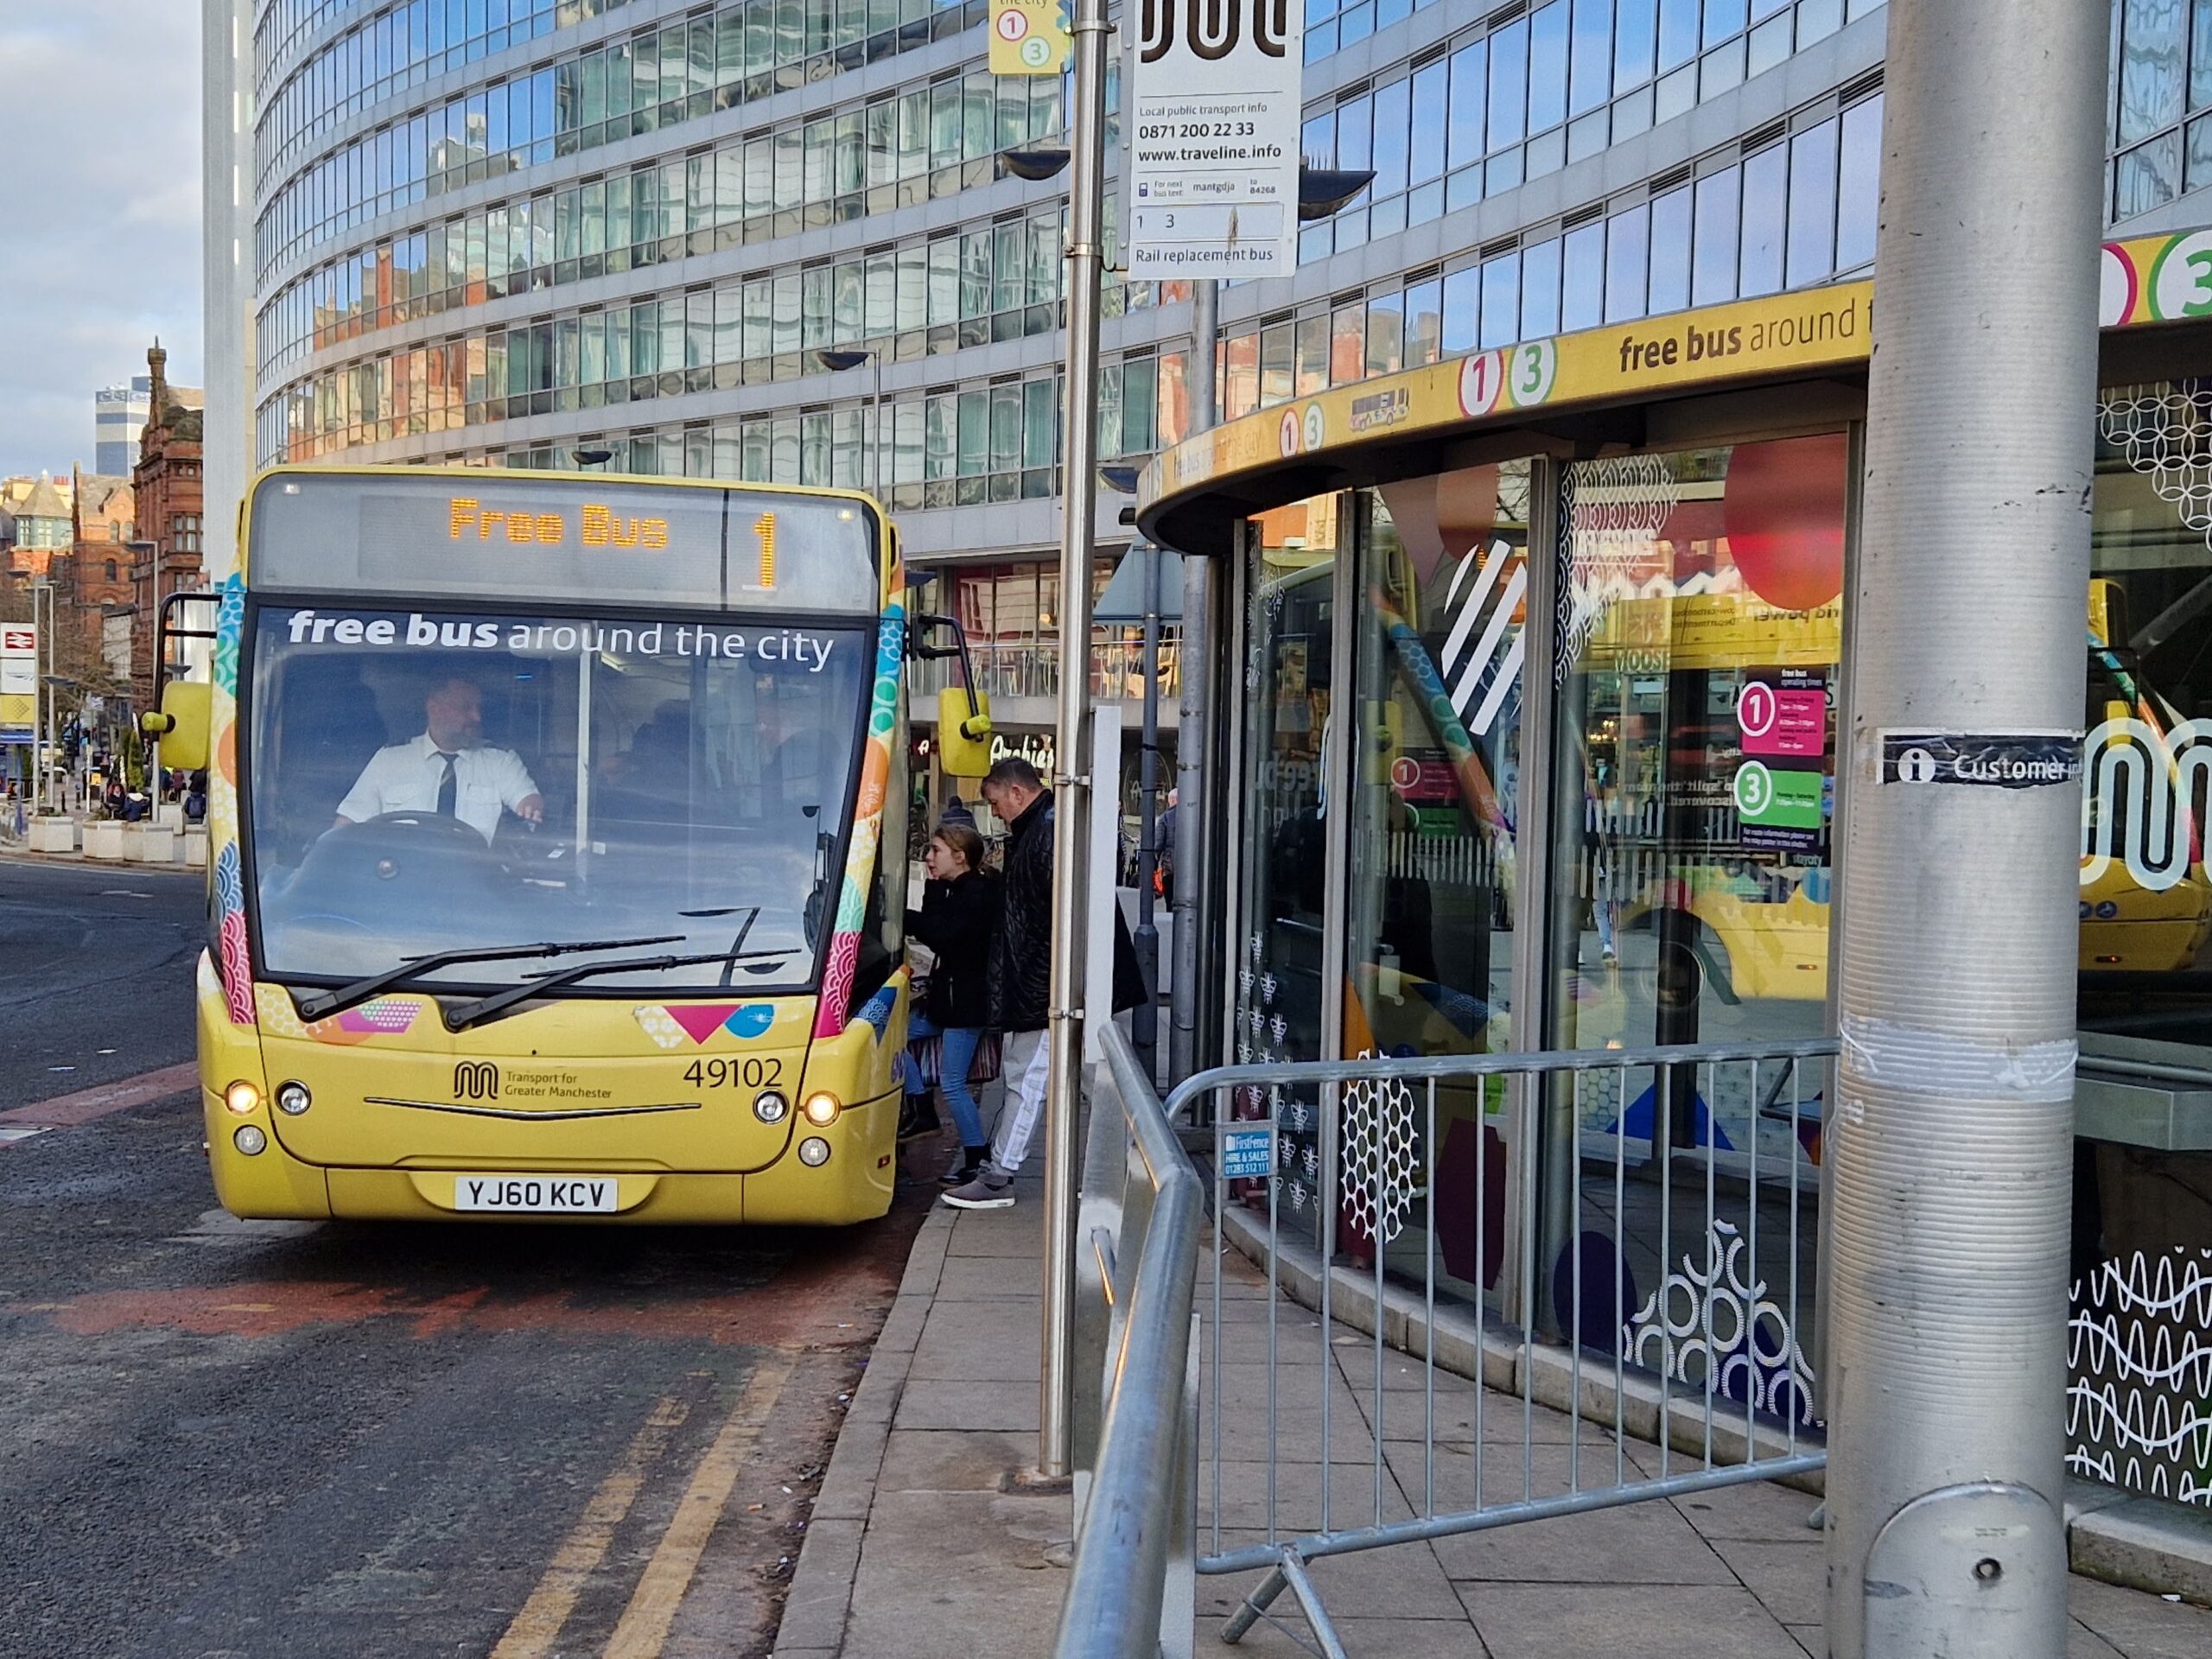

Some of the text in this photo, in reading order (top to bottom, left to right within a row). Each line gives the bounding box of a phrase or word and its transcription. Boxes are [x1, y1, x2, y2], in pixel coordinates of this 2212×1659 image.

[1007, 17, 1015, 34] 1
[1030, 43, 1042, 60] 3
[1139, 102, 1267, 118] Local public transport info
[1139, 122, 1255, 139] 0871 200 22 33
[1139, 143, 1281, 161] www.traveline.info
[1137, 214, 1174, 228] 1 3
[1136, 248, 1273, 264] Rail replacement bus
[1472, 356, 1486, 403] 1
[1522, 344, 1542, 393] 3
[1620, 335, 1677, 372] free
[1687, 324, 1742, 362] bus
[1750, 297, 1856, 351] around
[1286, 422, 1293, 451] 1
[1309, 415, 1318, 446] 3
[448, 498, 776, 589] Free Bus 1
[287, 610, 835, 672] free bus around the city
[1782, 669, 1794, 677] free
[1749, 695, 1761, 724] 1
[1400, 764, 1408, 781] 1
[1954, 754, 2063, 780] Customer
[1745, 772, 1759, 804] 3
[505, 1071, 577, 1085] Transport for
[683, 1058, 783, 1089] 49102
[505, 1085, 612, 1099] Greater Manchester
[1236, 1135, 1268, 1150] FirstFence
[1248, 1151, 1268, 1161] SALES
[468, 1181, 605, 1208] YJ60 KCV
